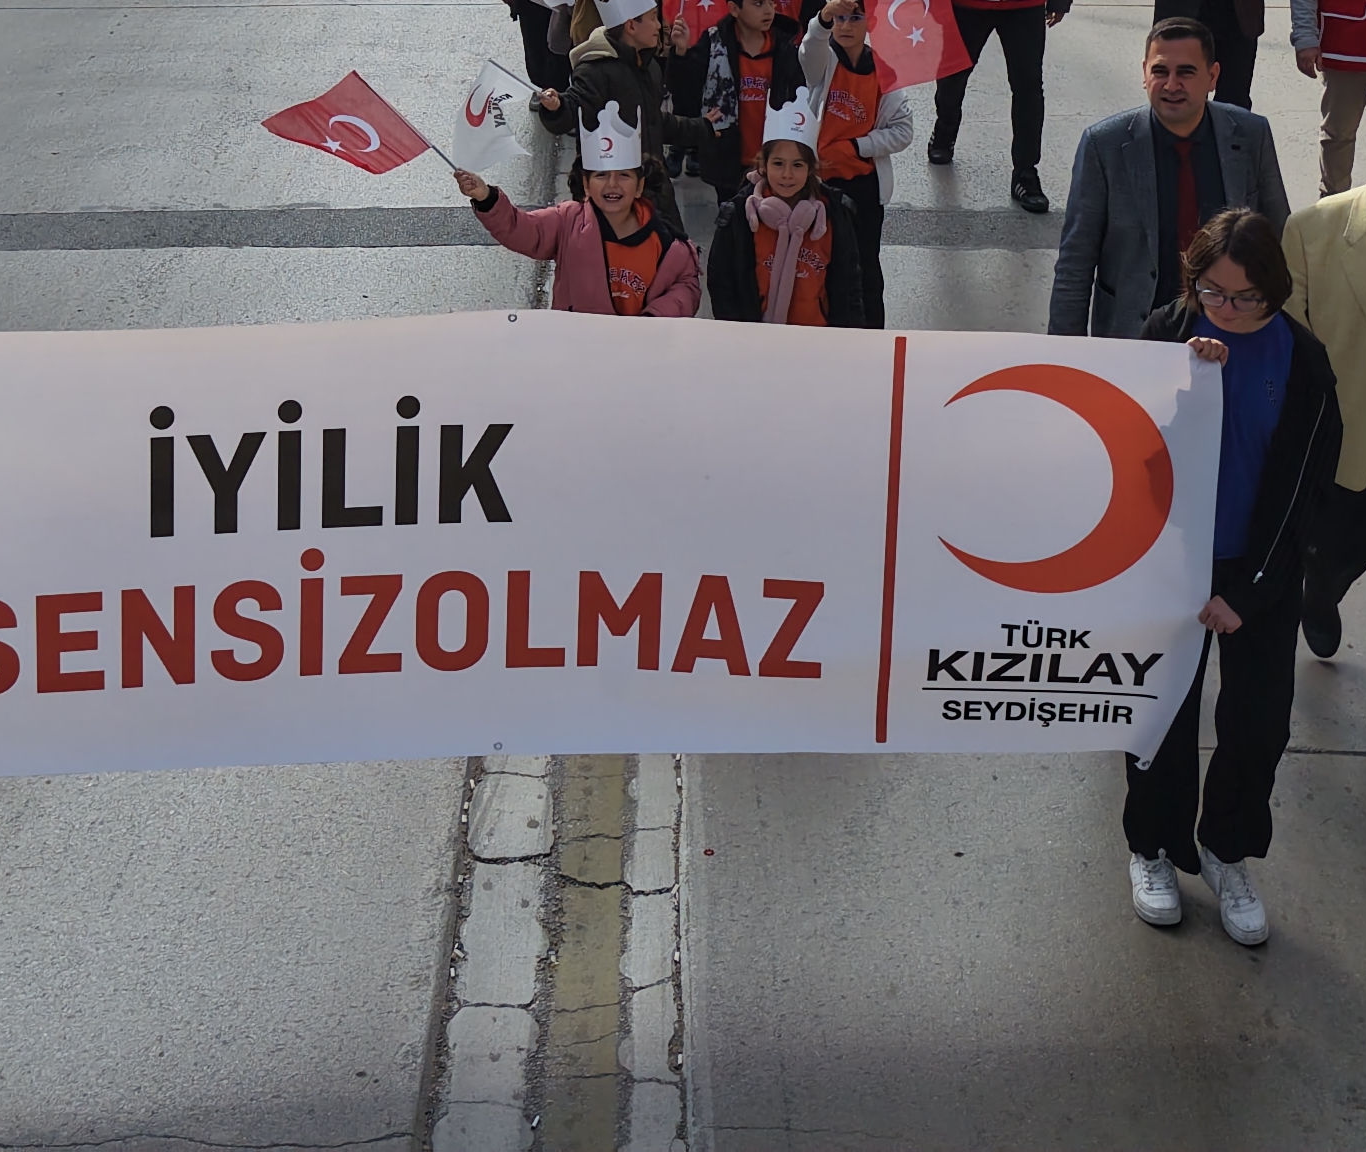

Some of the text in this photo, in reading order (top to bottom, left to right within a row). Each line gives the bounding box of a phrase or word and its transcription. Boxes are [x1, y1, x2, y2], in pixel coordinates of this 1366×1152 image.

[150, 396, 513, 538] İYİLİK
[1001, 619, 1092, 649] TÜRK
[926, 649, 1164, 686] KIZILAY
[942, 698, 1133, 727] SEYDİŞEHİR
